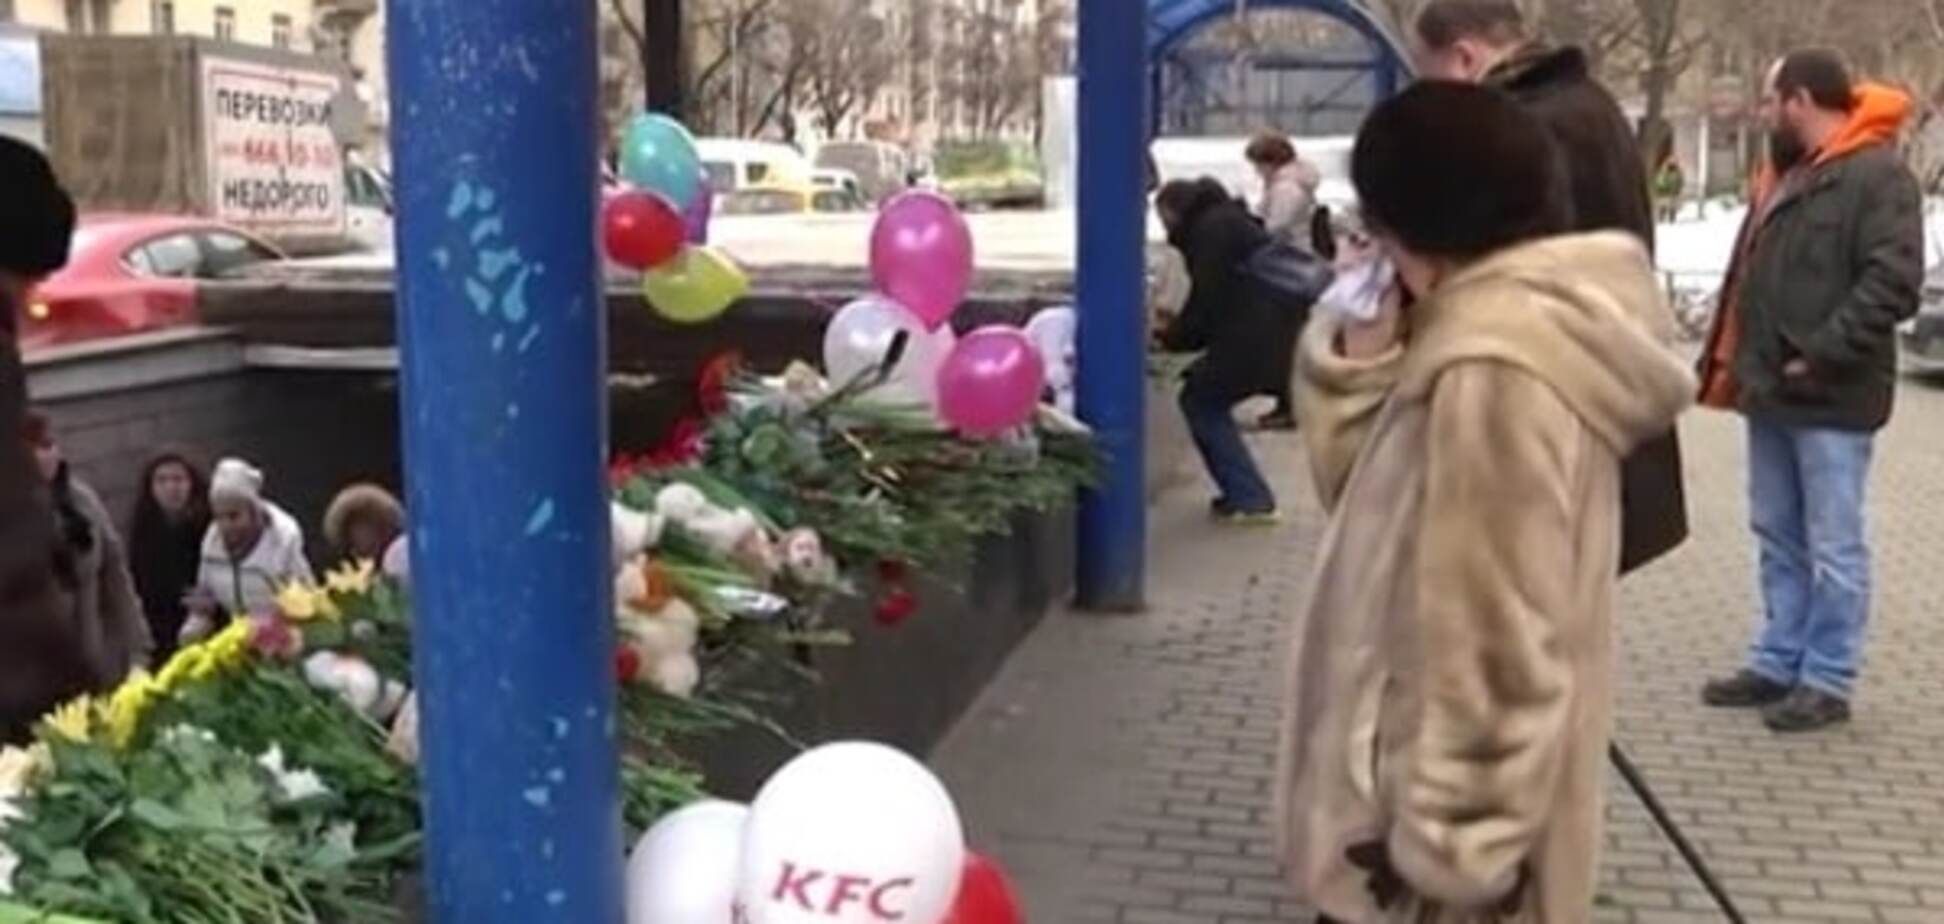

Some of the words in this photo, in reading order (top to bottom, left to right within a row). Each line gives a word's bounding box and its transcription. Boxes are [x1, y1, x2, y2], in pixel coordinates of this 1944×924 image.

[216, 89, 332, 126] ПЕРЕВОЗКИ
[223, 178, 328, 213] НЕДОРОГО
[773, 861, 914, 921] KFC
